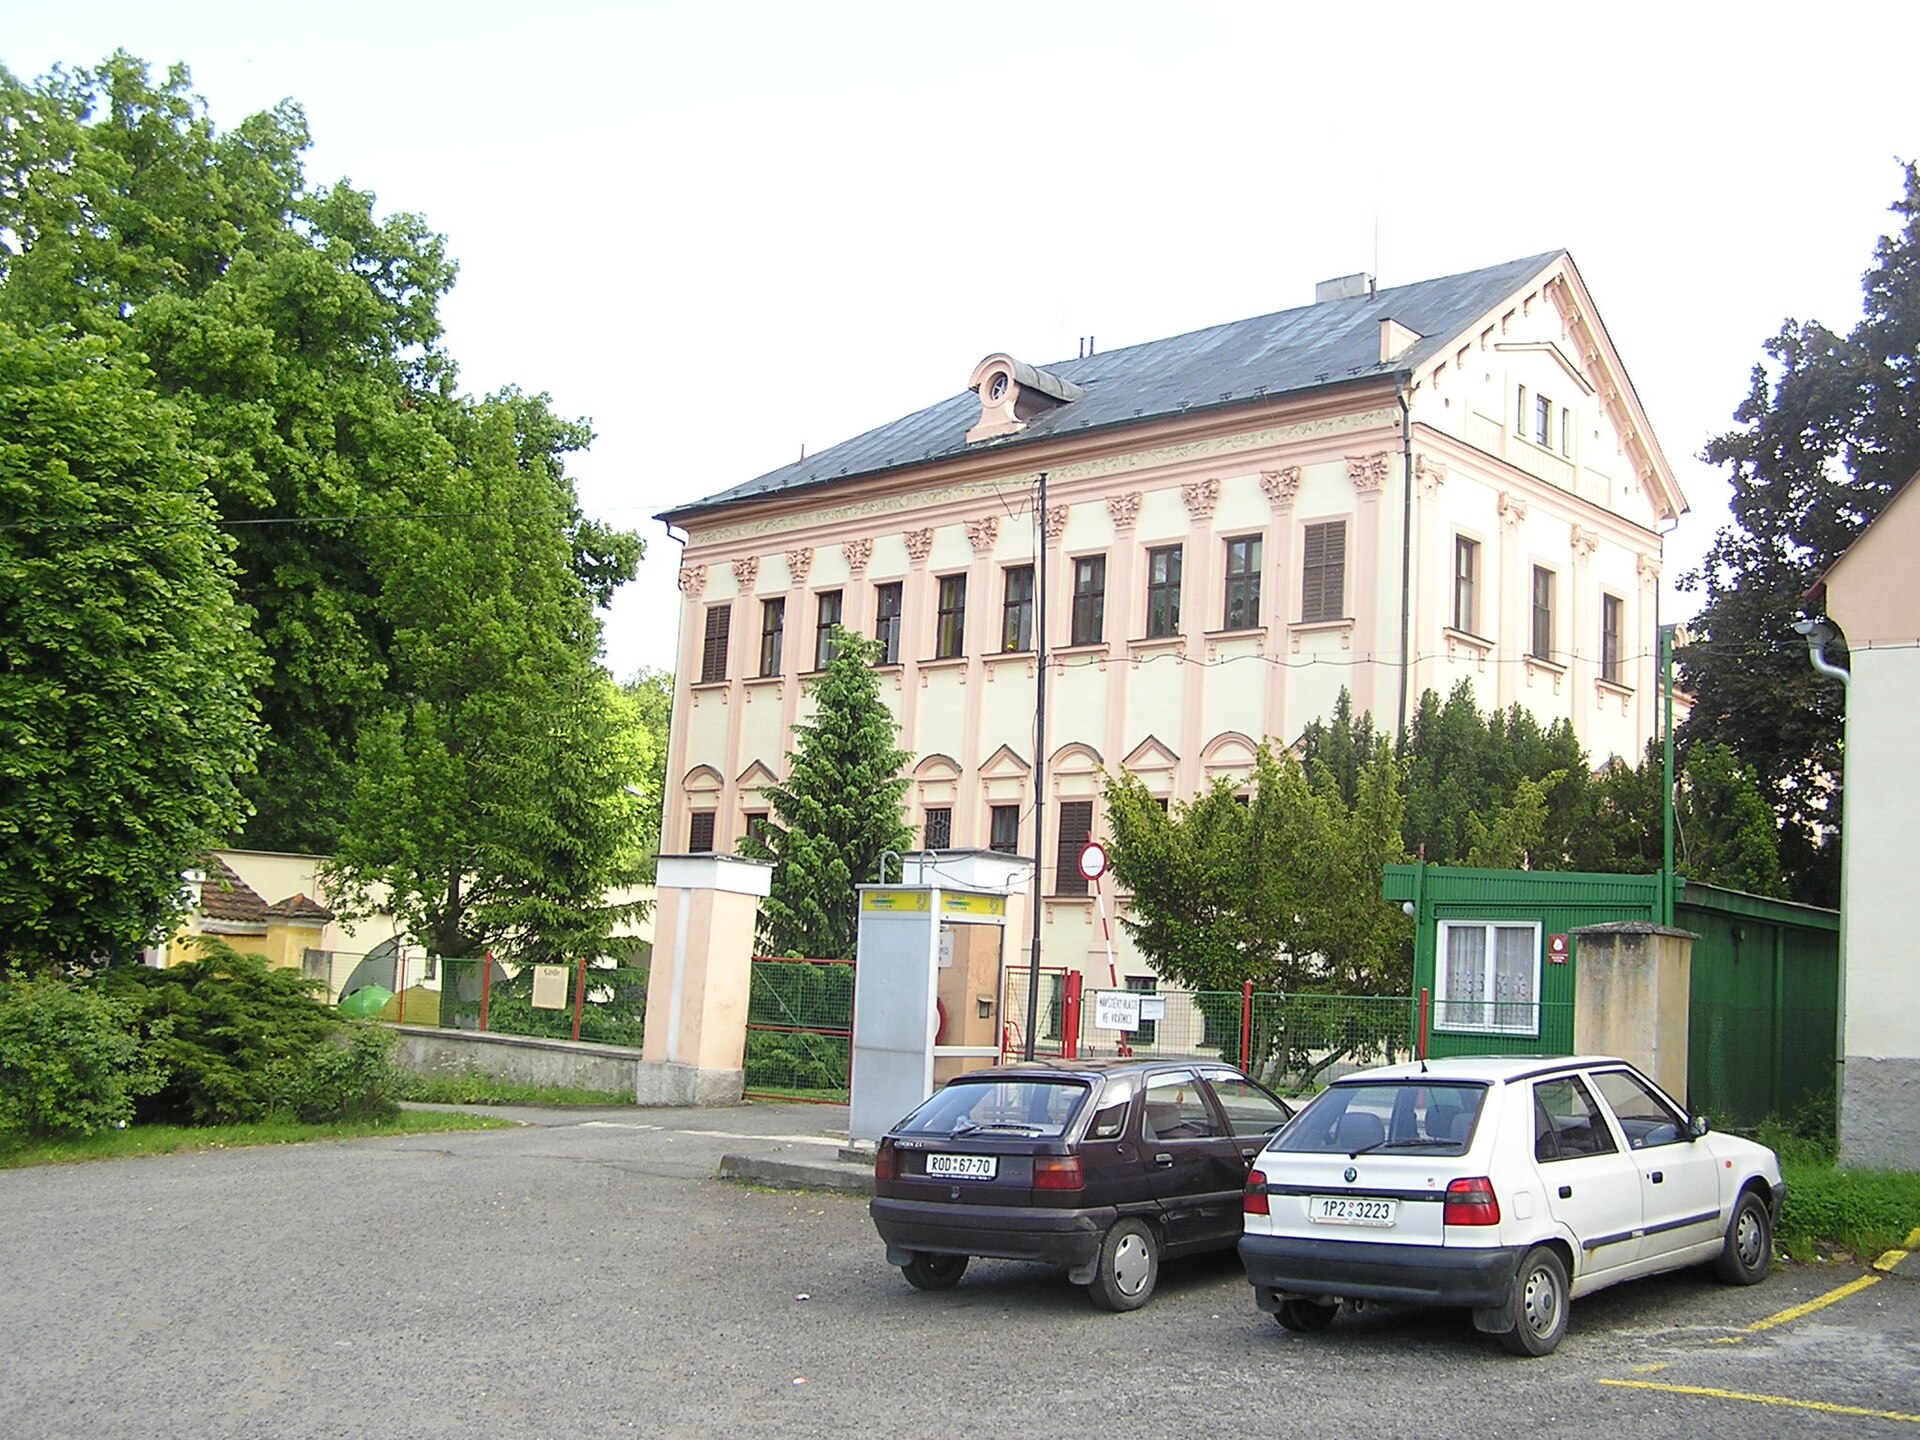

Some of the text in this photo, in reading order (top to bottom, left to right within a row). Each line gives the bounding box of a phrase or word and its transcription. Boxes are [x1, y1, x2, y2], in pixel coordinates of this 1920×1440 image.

[931, 1157, 952, 1172] ROD
[958, 1159, 991, 1174] 67-70
[1322, 1200, 1390, 1220] 1P2 3223
